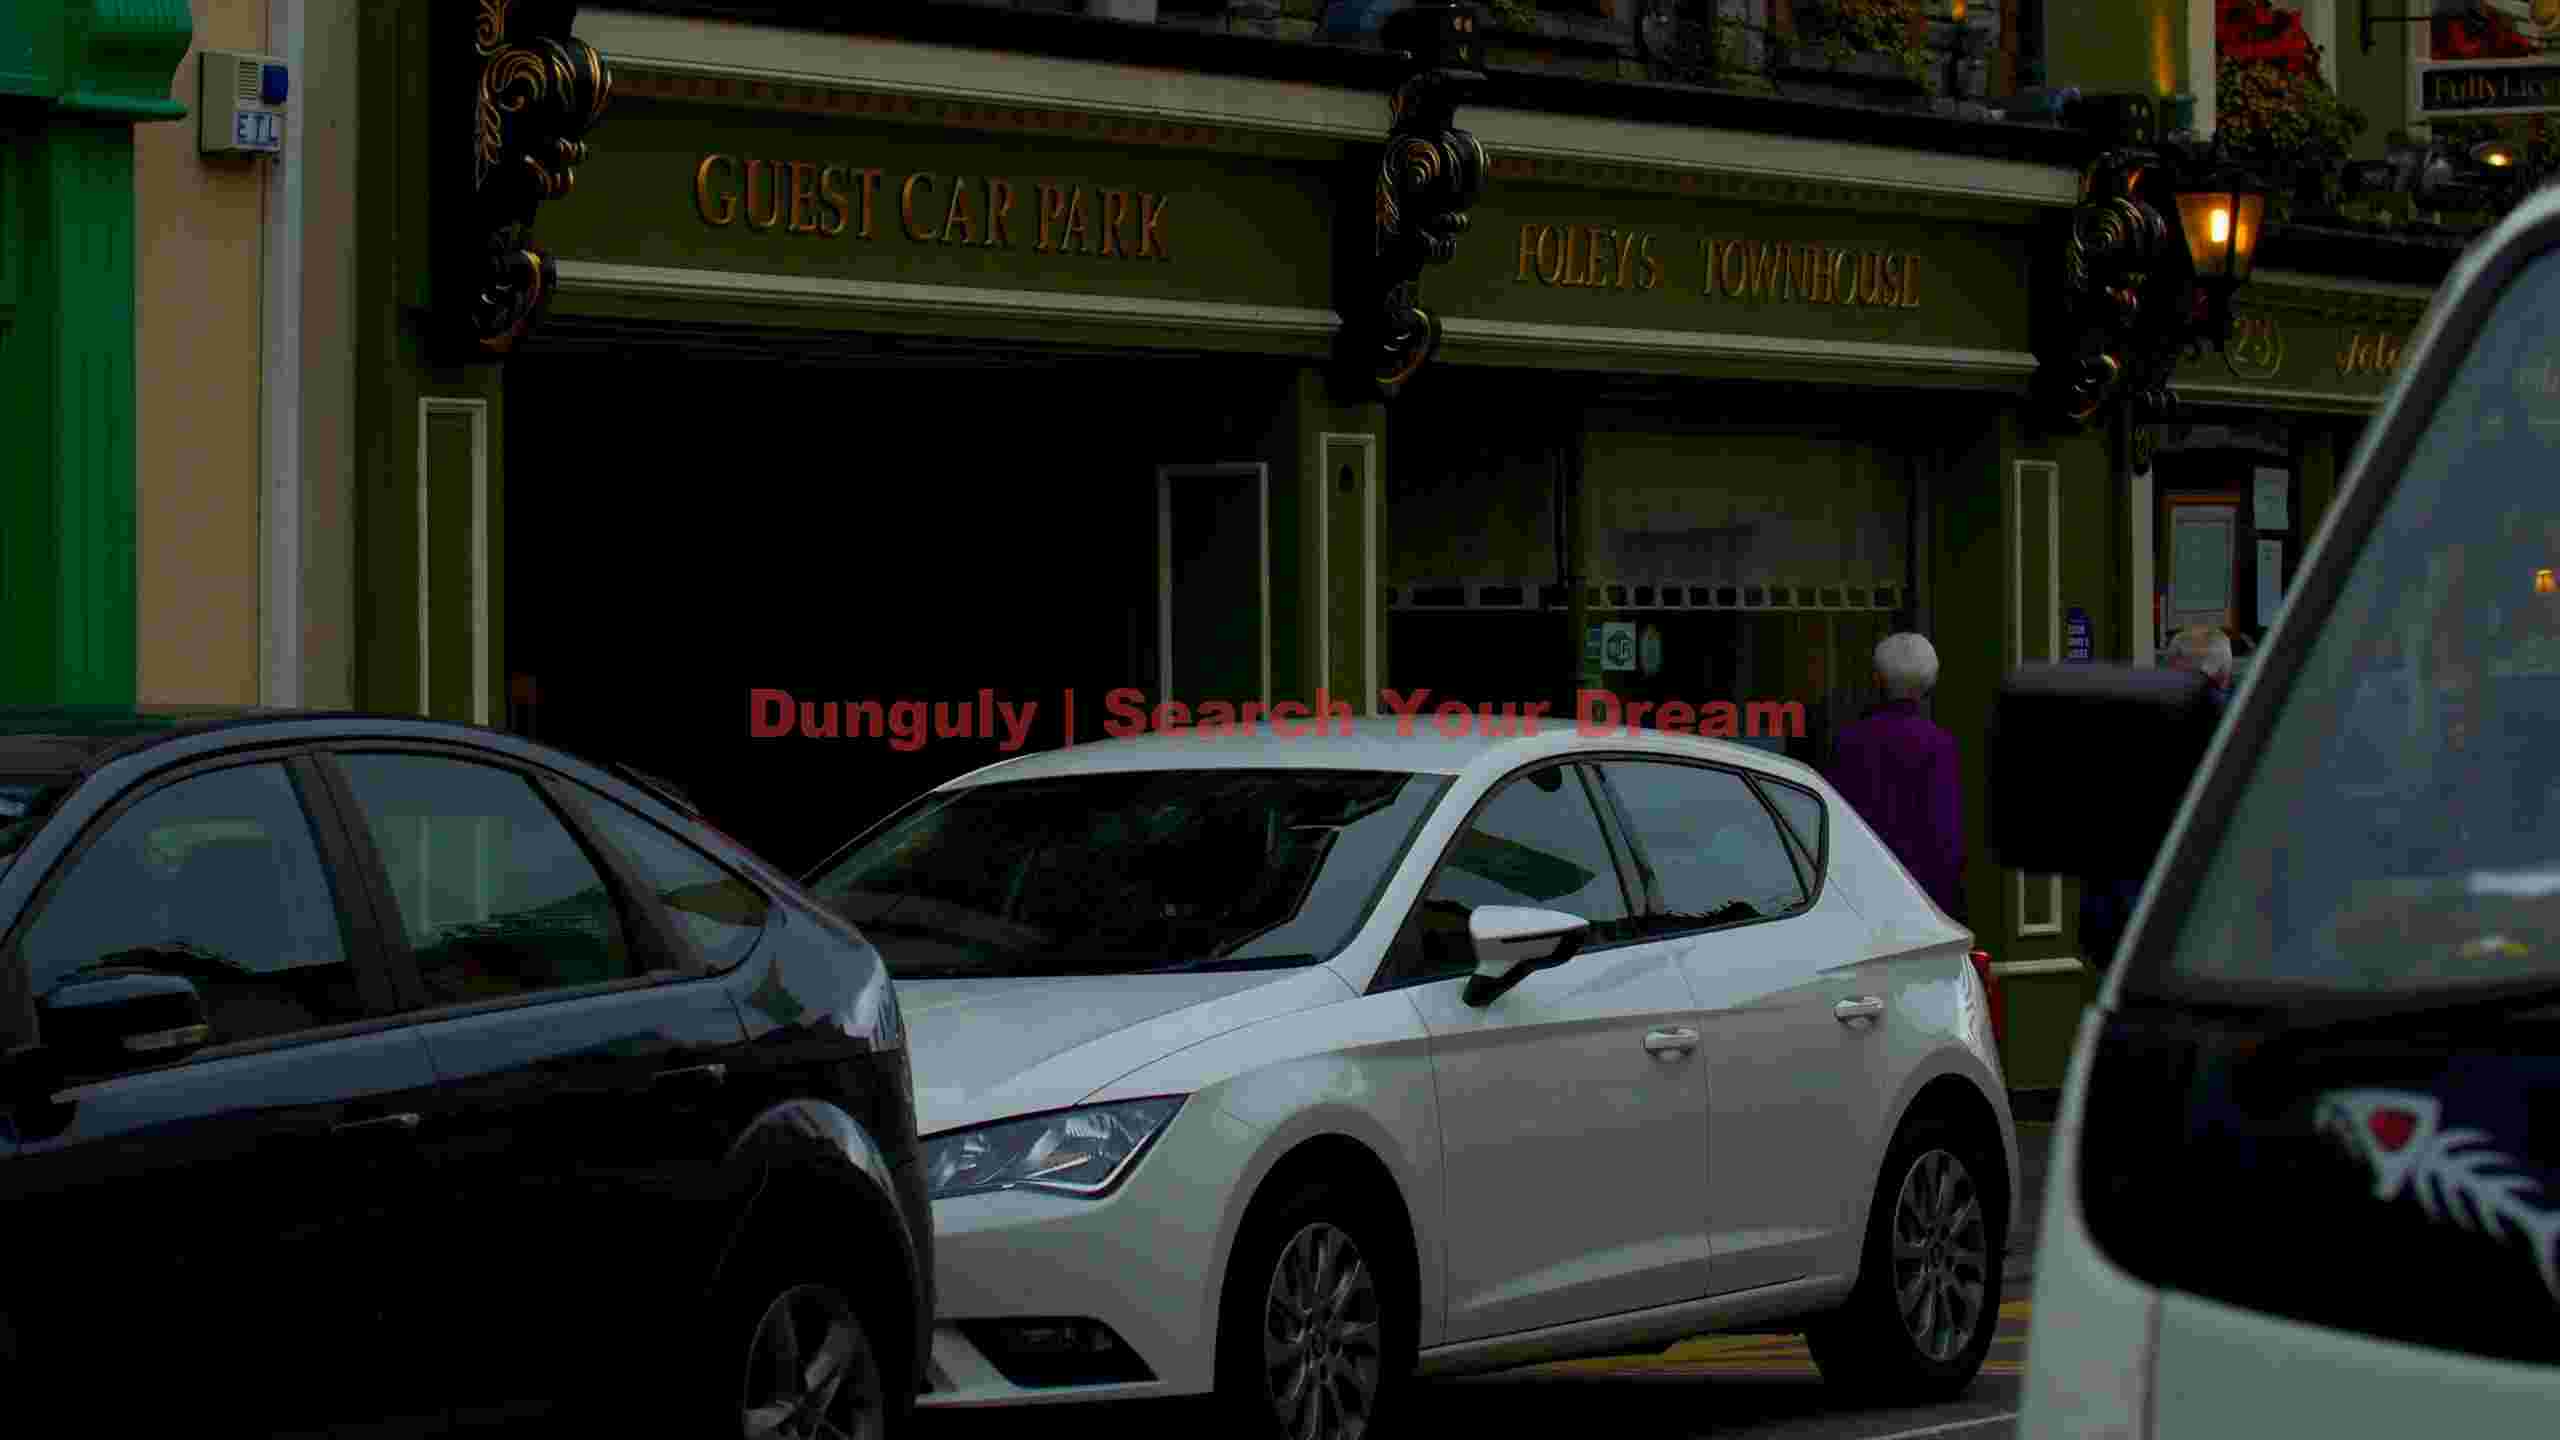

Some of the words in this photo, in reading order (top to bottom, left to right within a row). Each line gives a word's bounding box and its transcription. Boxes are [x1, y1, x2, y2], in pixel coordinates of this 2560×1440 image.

[694, 152, 885, 240] GUEST
[899, 169, 1018, 249] CAR
[1031, 181, 1173, 261] PARK
[1701, 238, 1921, 310] TOWNHOUSE
